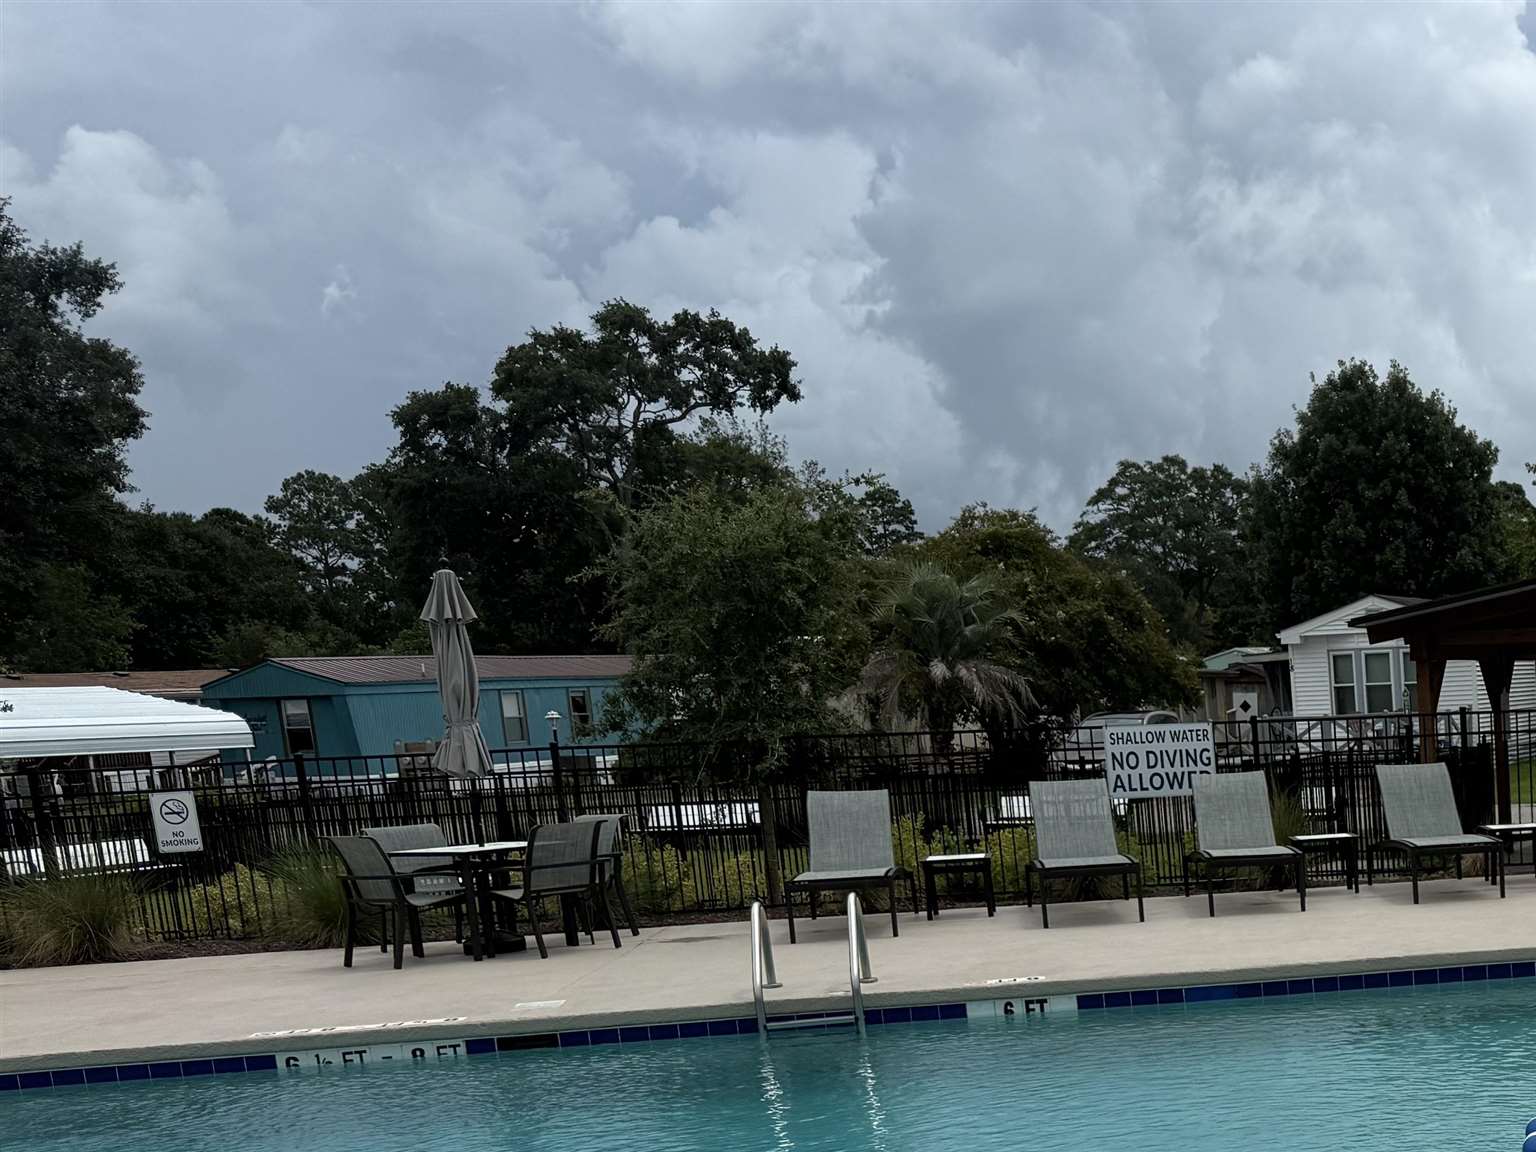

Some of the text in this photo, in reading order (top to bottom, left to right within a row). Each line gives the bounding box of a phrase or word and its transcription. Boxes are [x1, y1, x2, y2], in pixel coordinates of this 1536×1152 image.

[1109, 728, 1210, 745] SHALLOW WATER
[1110, 748, 1212, 771] NO DIVING
[172, 830, 185, 838] NO
[161, 838, 199, 848] SMOKING
[1003, 998, 1048, 1015] 6 FT
[341, 1050, 368, 1065] FT
[436, 1044, 461, 1057] FT
